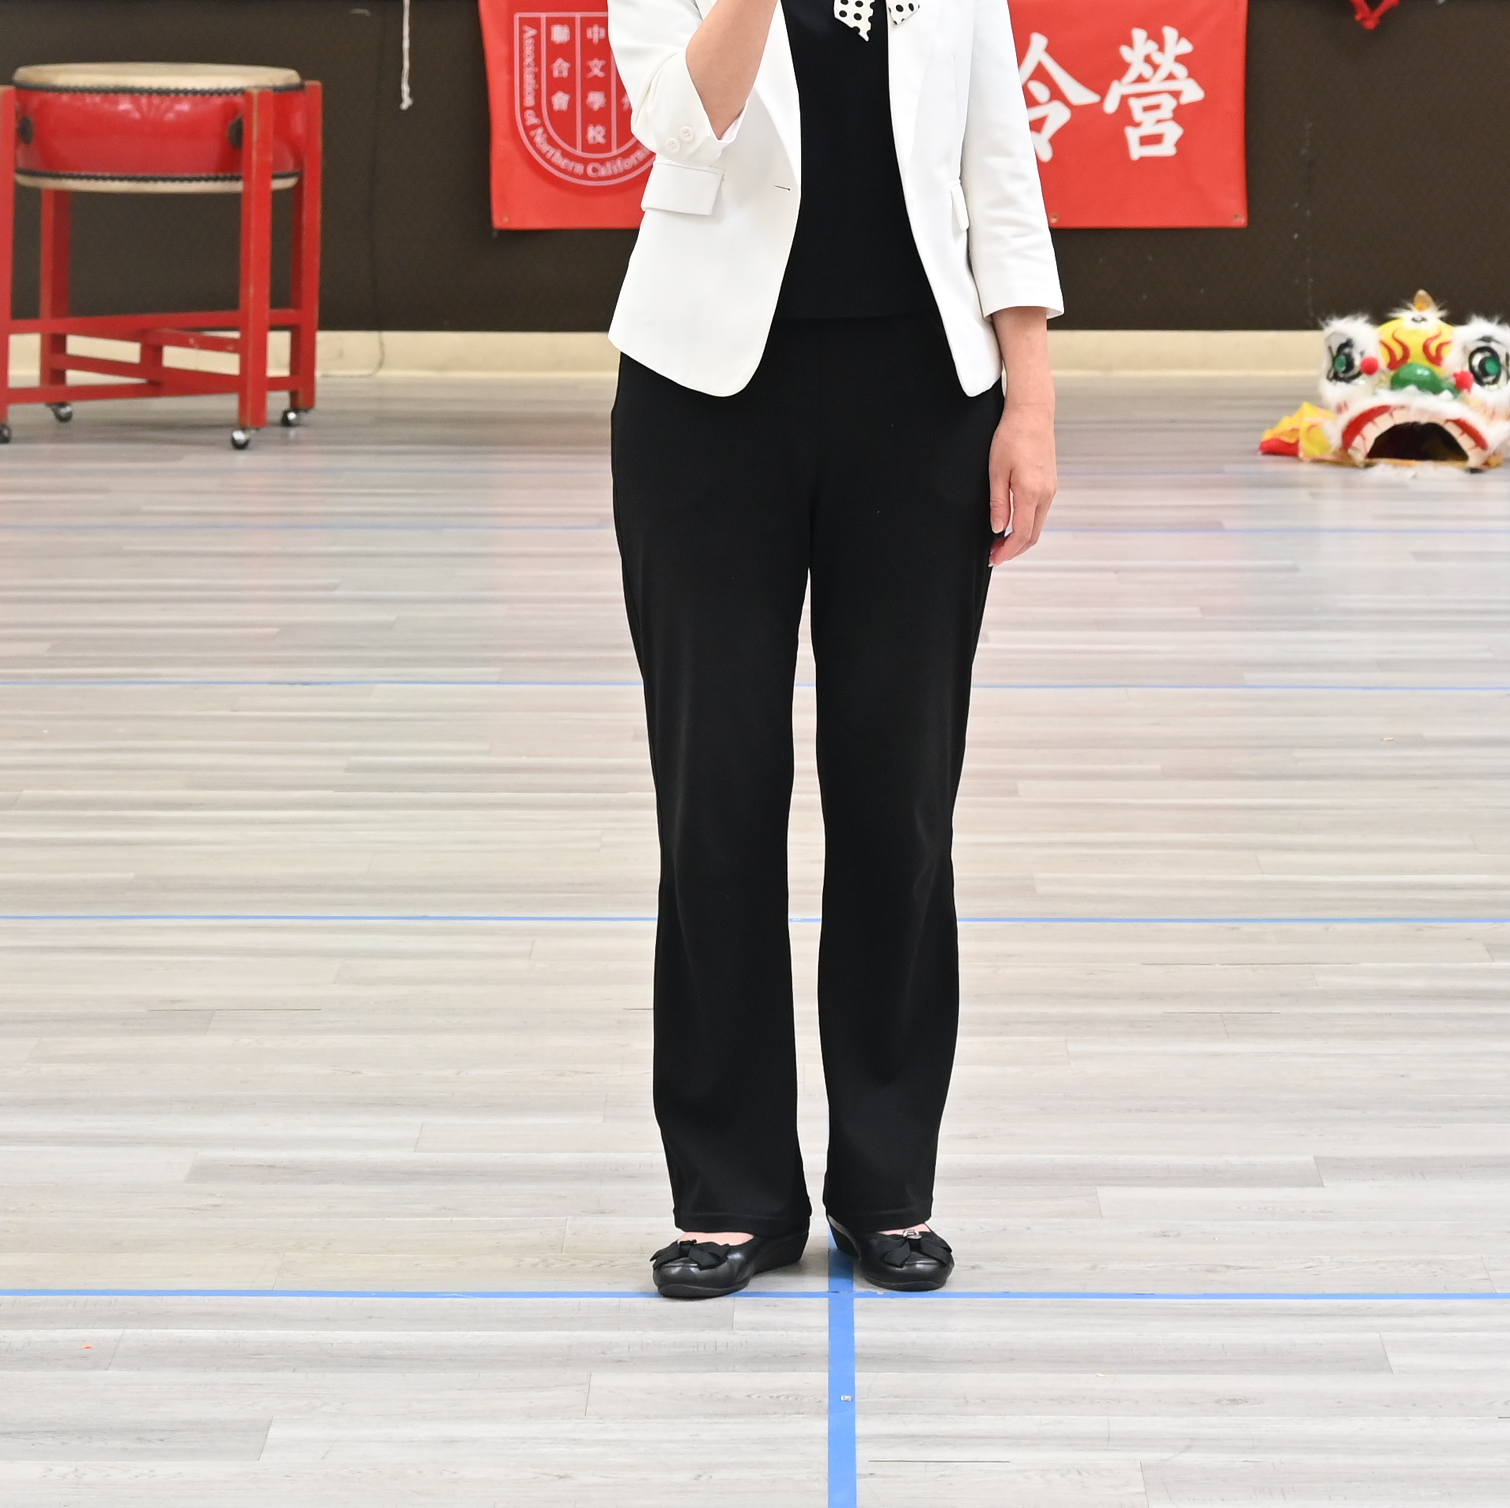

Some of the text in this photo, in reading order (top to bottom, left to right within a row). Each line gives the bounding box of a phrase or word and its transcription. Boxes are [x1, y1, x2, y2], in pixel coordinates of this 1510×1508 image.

[522, 25, 539, 108] Association
[585, 24, 607, 145] 中文學校
[1019, 26, 1206, 162] 令營
[523, 109, 541, 125] of
[529, 126, 585, 176] Northern
